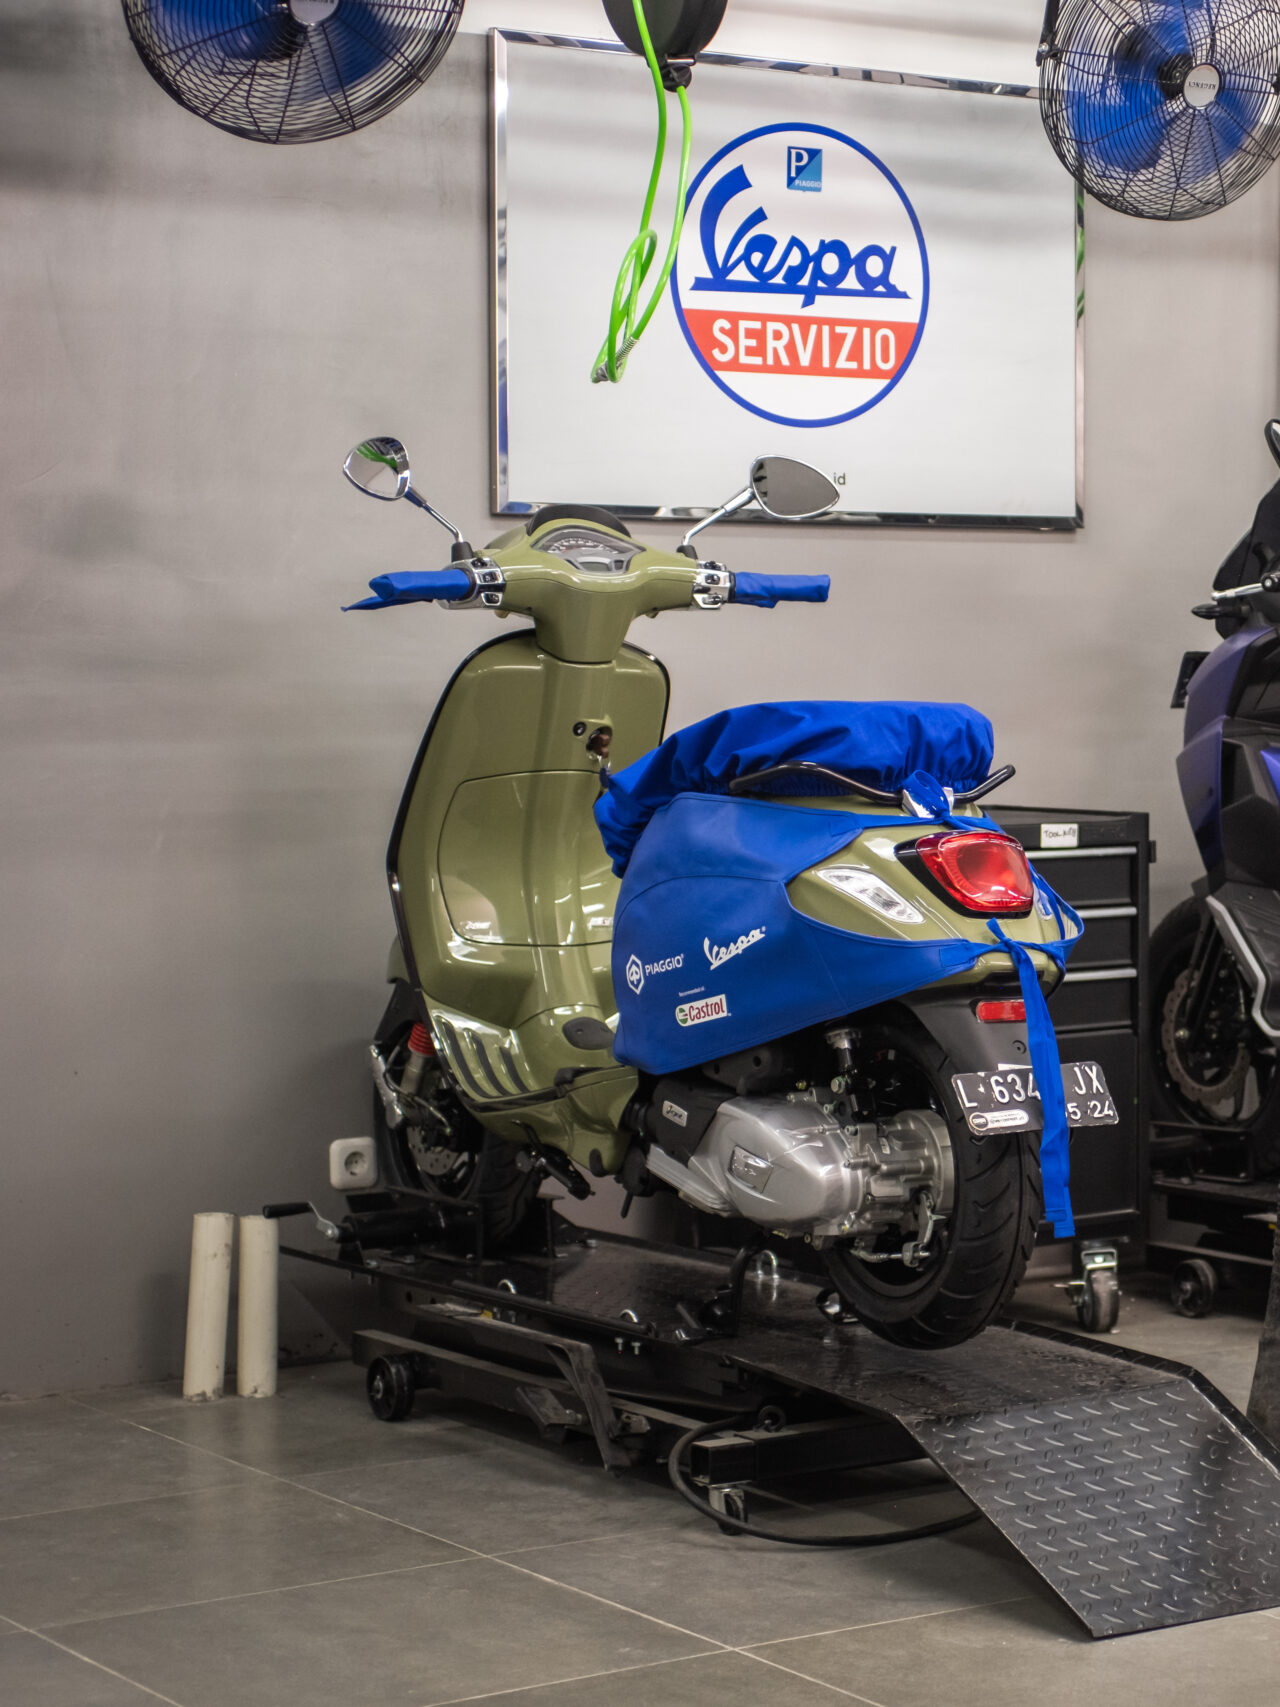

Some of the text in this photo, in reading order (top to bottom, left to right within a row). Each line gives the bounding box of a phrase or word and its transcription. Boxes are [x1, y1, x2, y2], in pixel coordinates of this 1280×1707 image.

[794, 179, 822, 188] PIAGGIO
[689, 164, 912, 309] Vespa
[711, 318, 896, 371] SERVIZIO
[644, 955, 683, 976] PIAGGIO
[703, 928, 766, 971] Vespa
[688, 998, 726, 1022] Castrol
[957, 1065, 1105, 1108] L 634 JX
